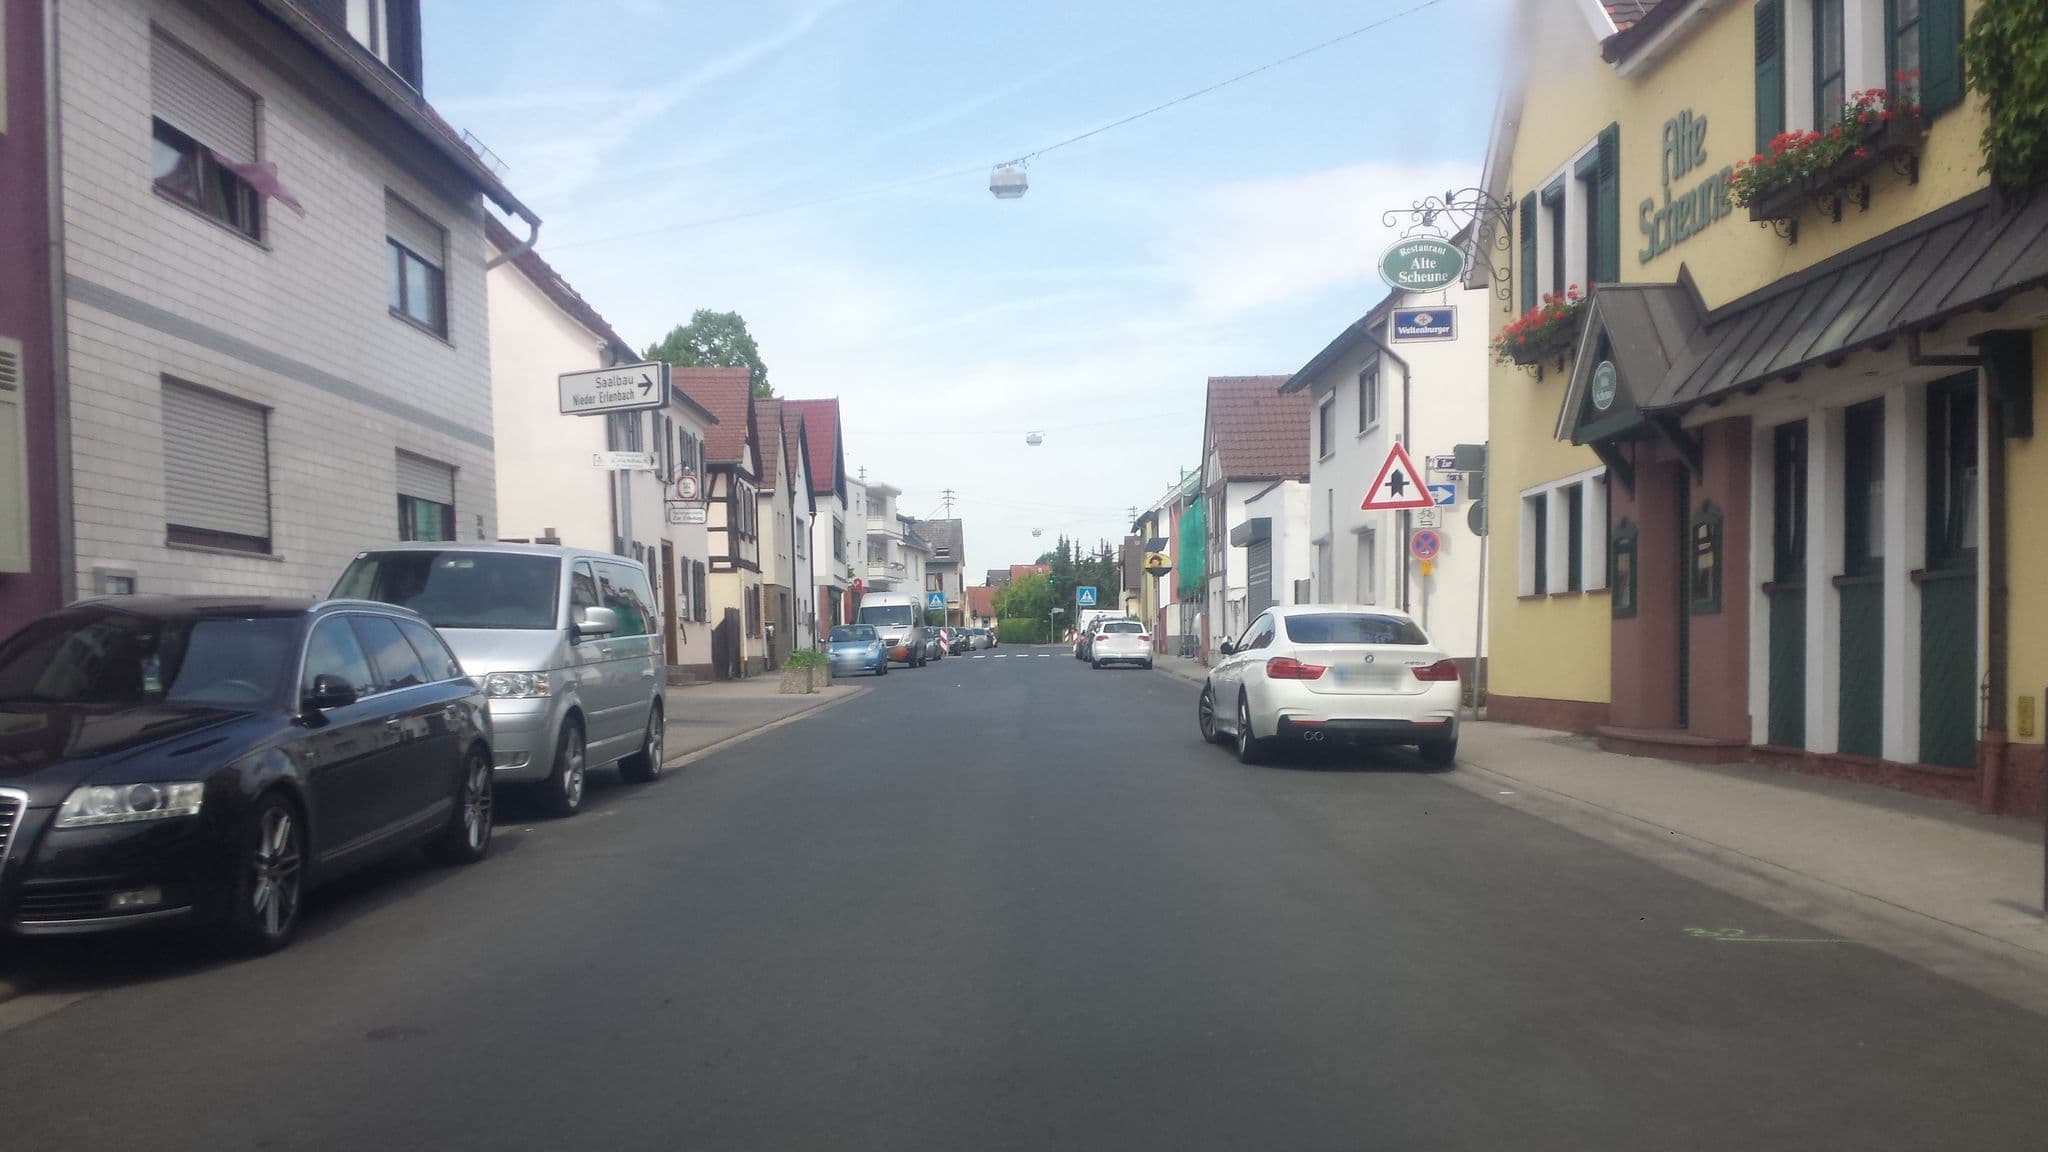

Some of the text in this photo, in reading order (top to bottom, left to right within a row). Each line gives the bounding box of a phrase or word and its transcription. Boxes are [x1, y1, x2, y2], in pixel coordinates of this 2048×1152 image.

[1662, 109, 1707, 185] Alte
[1638, 165, 1733, 264] Scheune
[1400, 244, 1447, 257] Restaurant
[1411, 258, 1437, 269] Alte
[1399, 271, 1448, 283] Scheune
[1398, 325, 1450, 334] Weltenburger
[595, 376, 634, 389] Saalbau
[573, 389, 635, 406] Nieder Erlenbach
